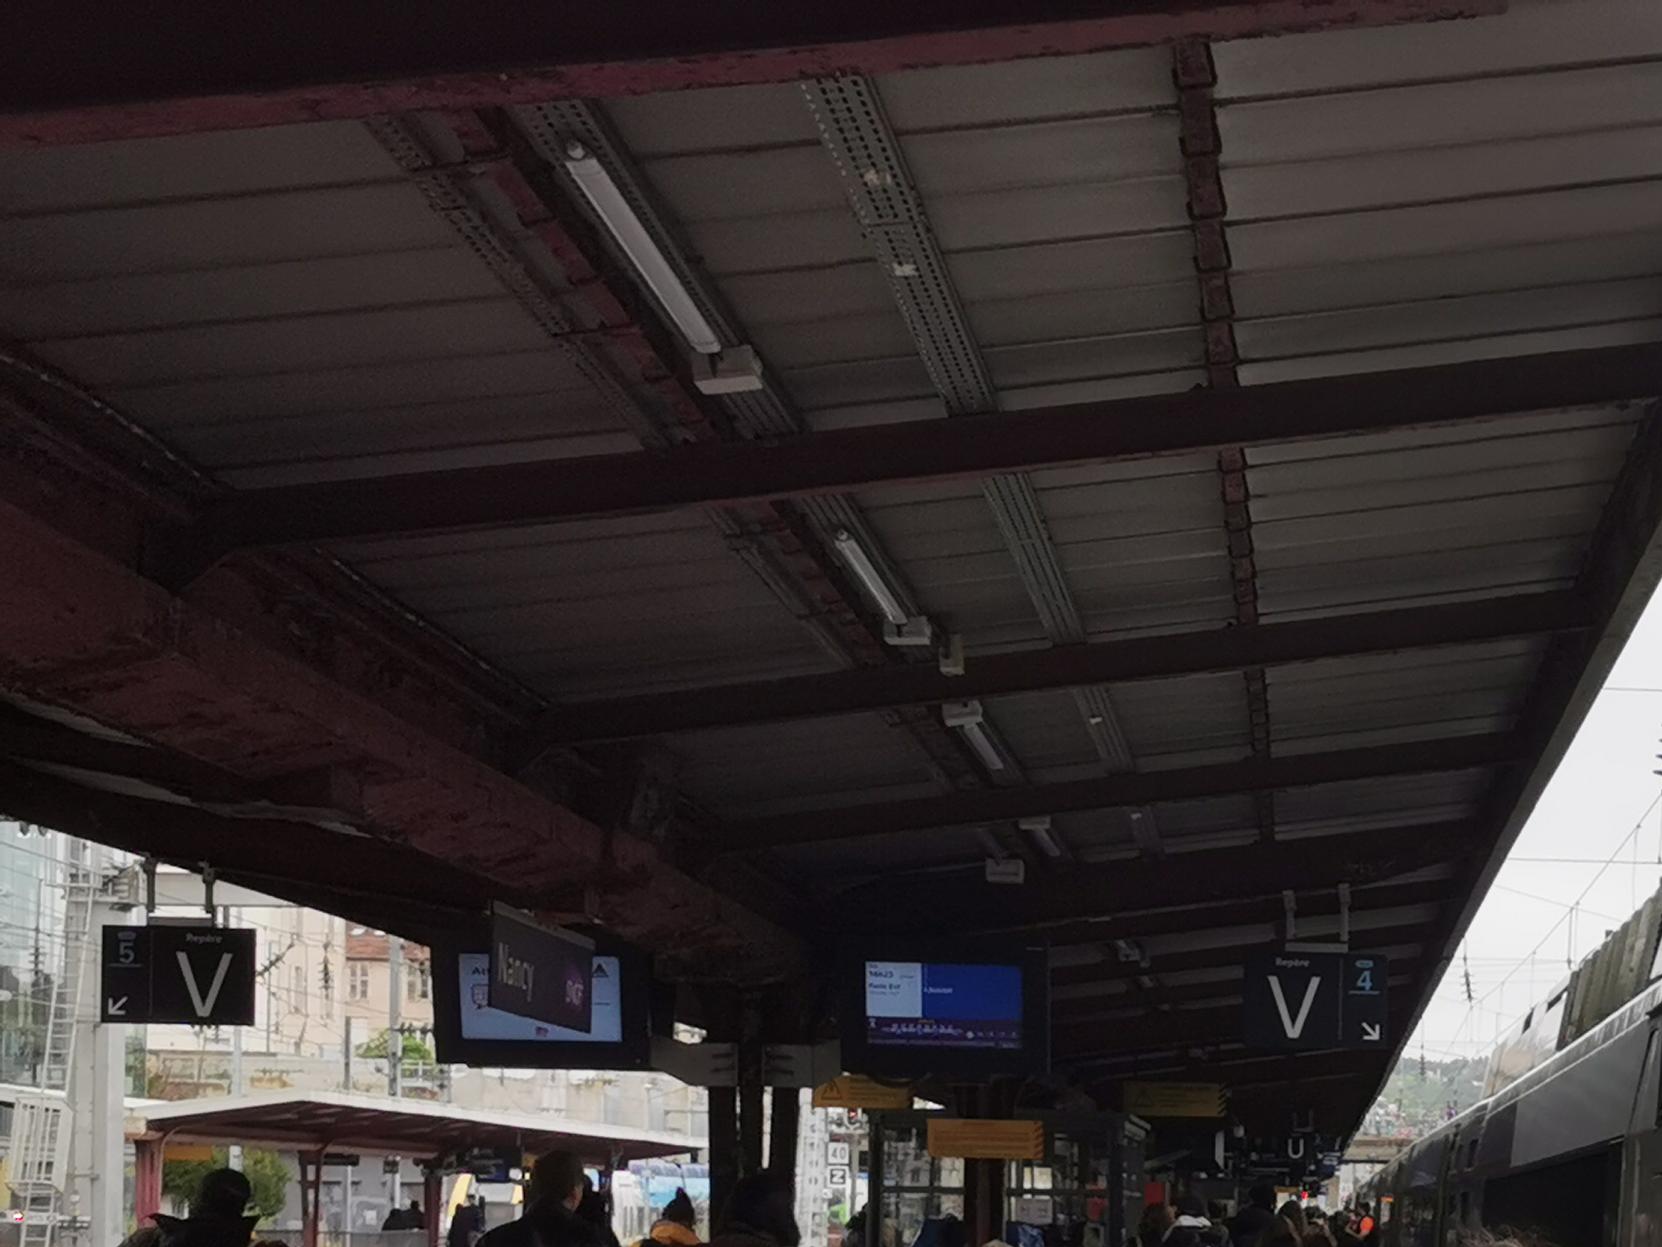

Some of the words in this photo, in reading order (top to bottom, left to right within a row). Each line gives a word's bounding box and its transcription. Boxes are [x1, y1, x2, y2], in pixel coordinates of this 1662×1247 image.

[118, 942, 136, 963] 5
[1275, 957, 1311, 968] Repère
[498, 941, 534, 1003] Nancy
[1355, 970, 1374, 991] 4
[176, 951, 234, 1018] V
[1266, 975, 1322, 1040] V
[831, 1146, 847, 1160] 40
[1287, 1138, 1305, 1160] U
